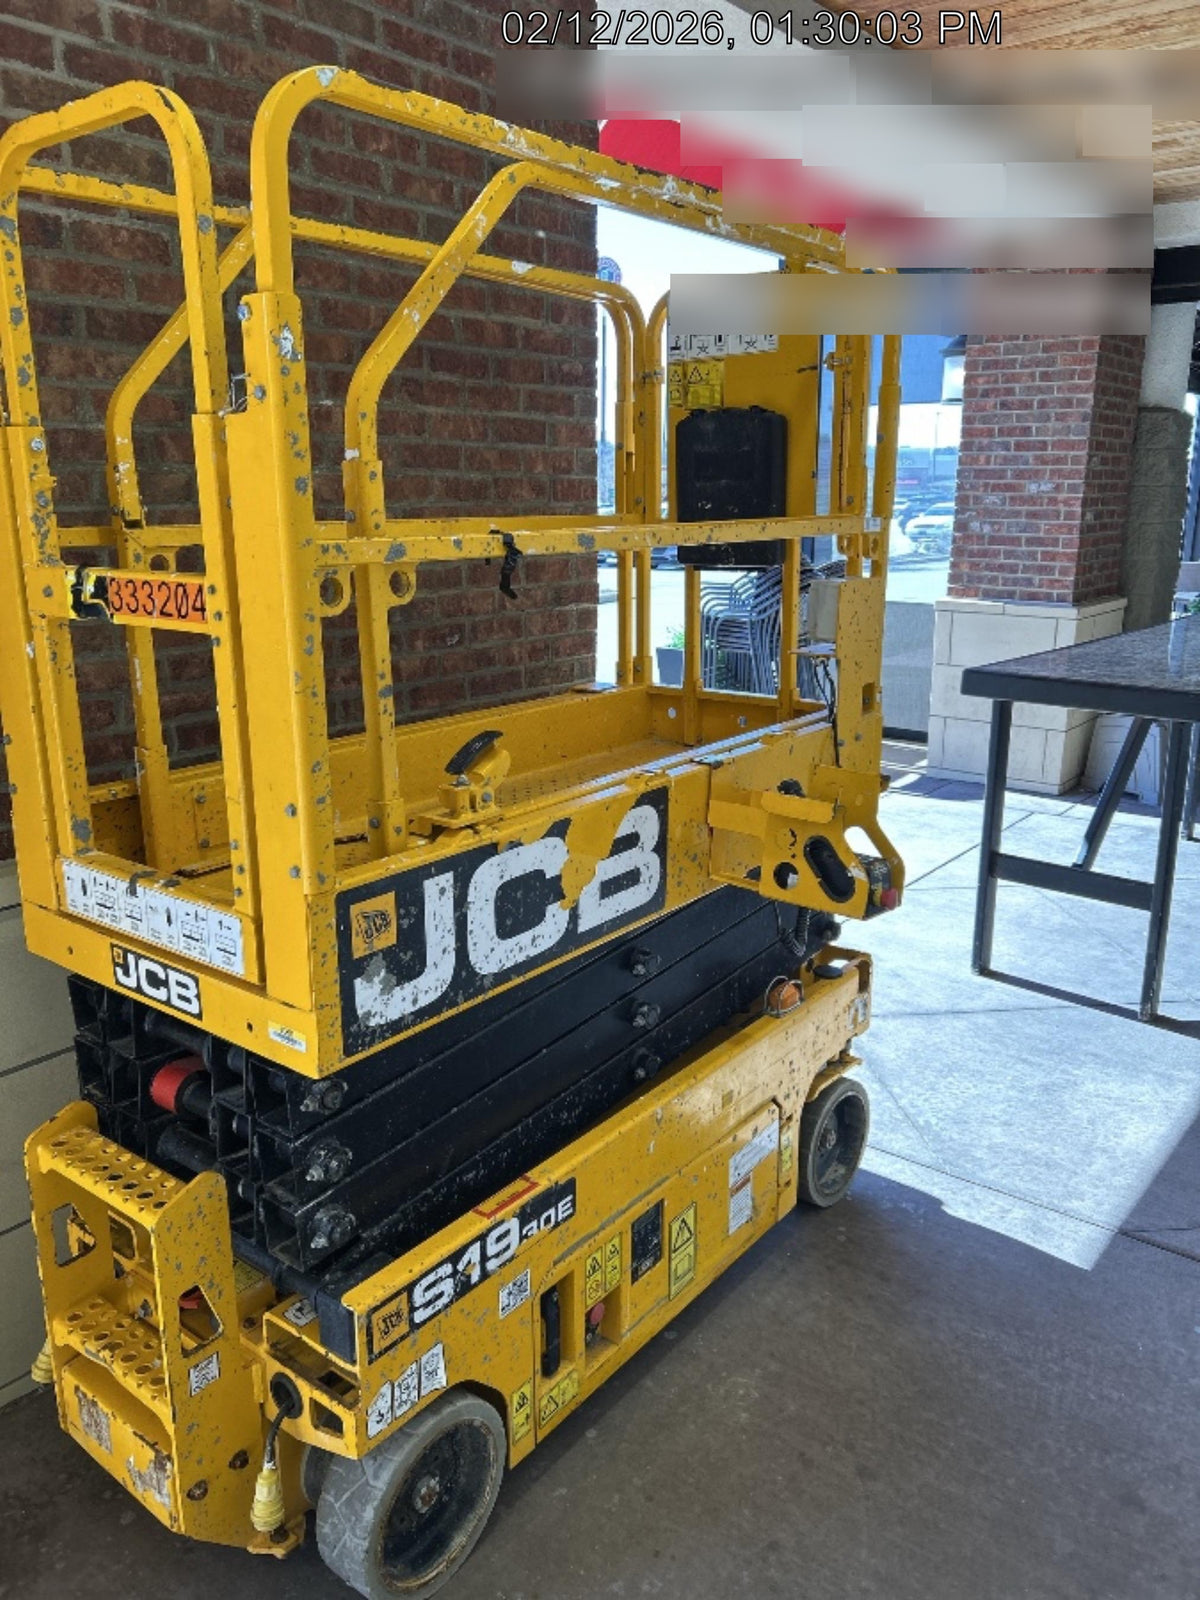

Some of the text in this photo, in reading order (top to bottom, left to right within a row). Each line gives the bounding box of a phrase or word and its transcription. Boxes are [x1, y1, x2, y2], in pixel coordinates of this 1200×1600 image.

[109, 577, 206, 621] 333204
[115, 953, 201, 1015] JCB
[412, 1216, 520, 1325] S19
